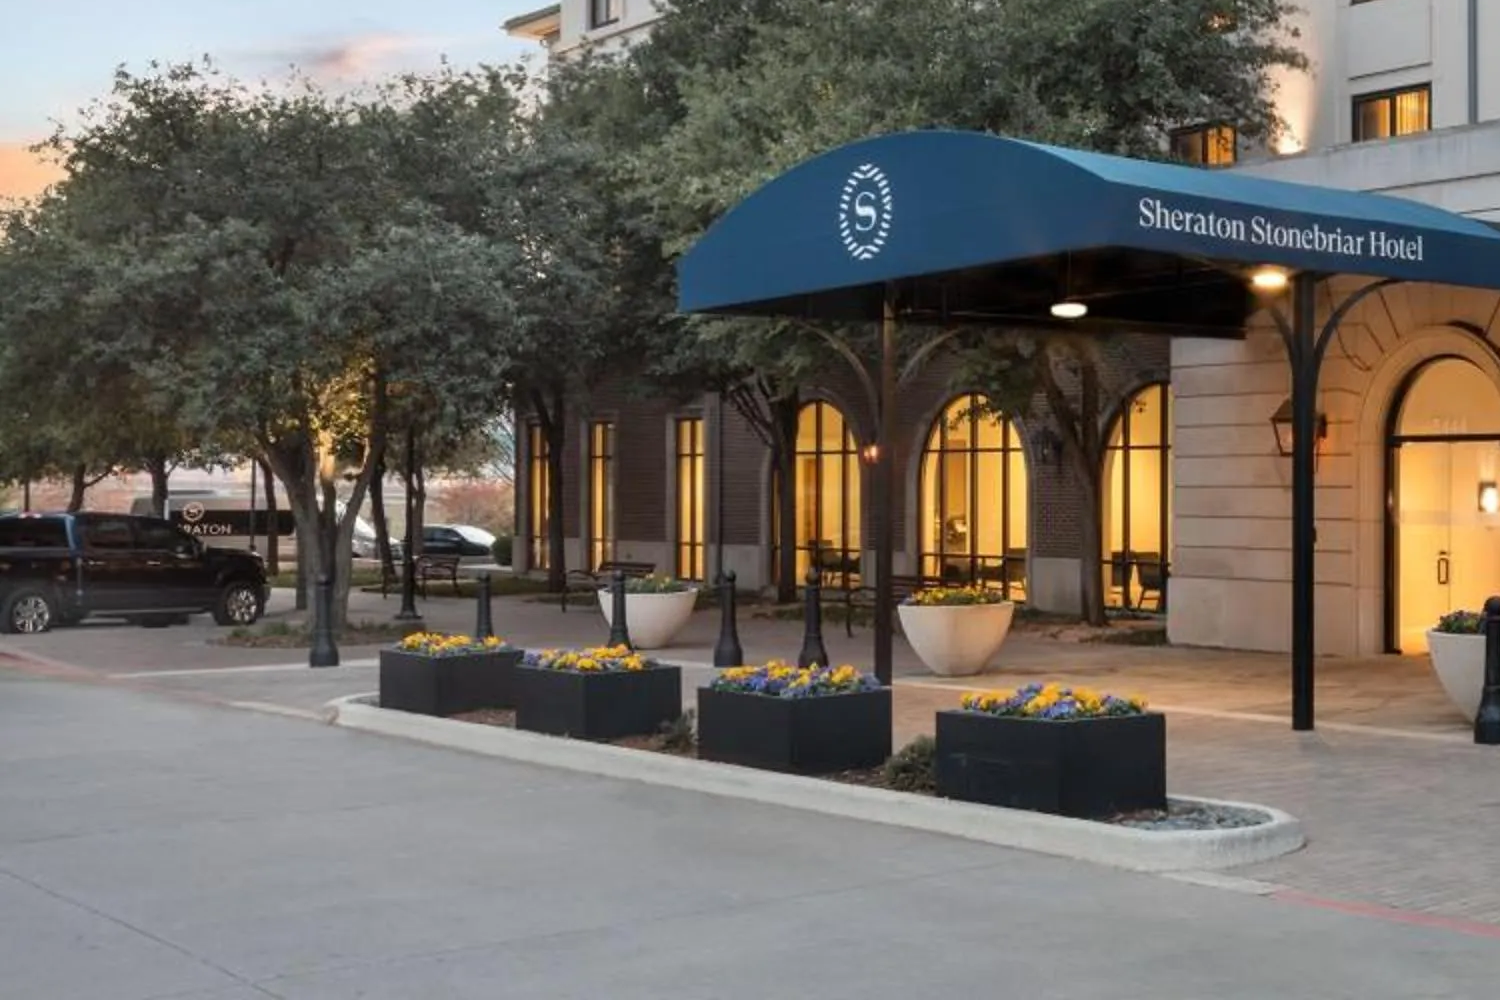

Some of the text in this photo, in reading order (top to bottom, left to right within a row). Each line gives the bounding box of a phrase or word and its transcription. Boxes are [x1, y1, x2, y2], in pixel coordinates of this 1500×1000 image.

[855, 191, 877, 231] S
[1138, 197, 1423, 261] Sheraton Stonebriar Hotel
